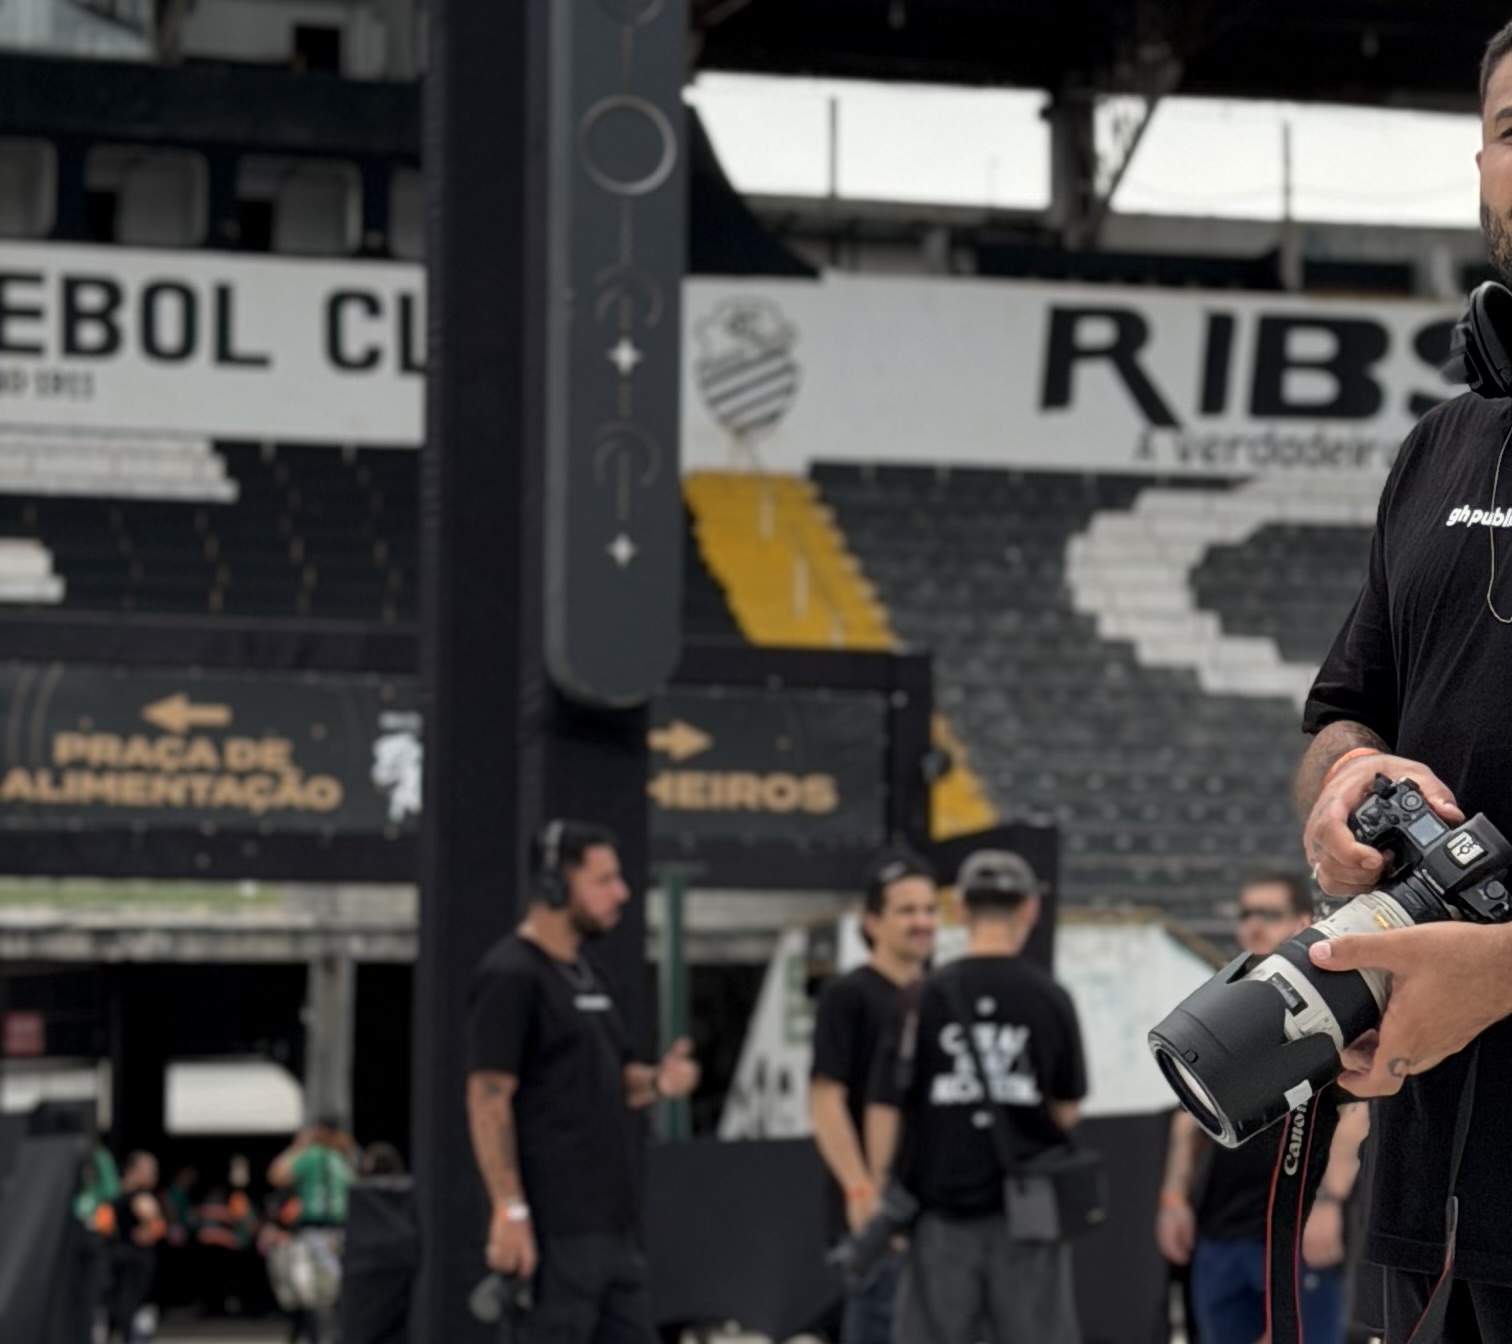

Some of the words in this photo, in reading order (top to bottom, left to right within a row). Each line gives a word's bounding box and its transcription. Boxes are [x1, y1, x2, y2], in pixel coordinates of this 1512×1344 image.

[52, 730, 220, 772] PRAÇA
[224, 737, 295, 770] DE
[0, 765, 345, 816] ALIMENTAÇÃO
[1283, 1100, 1309, 1176] Canon
